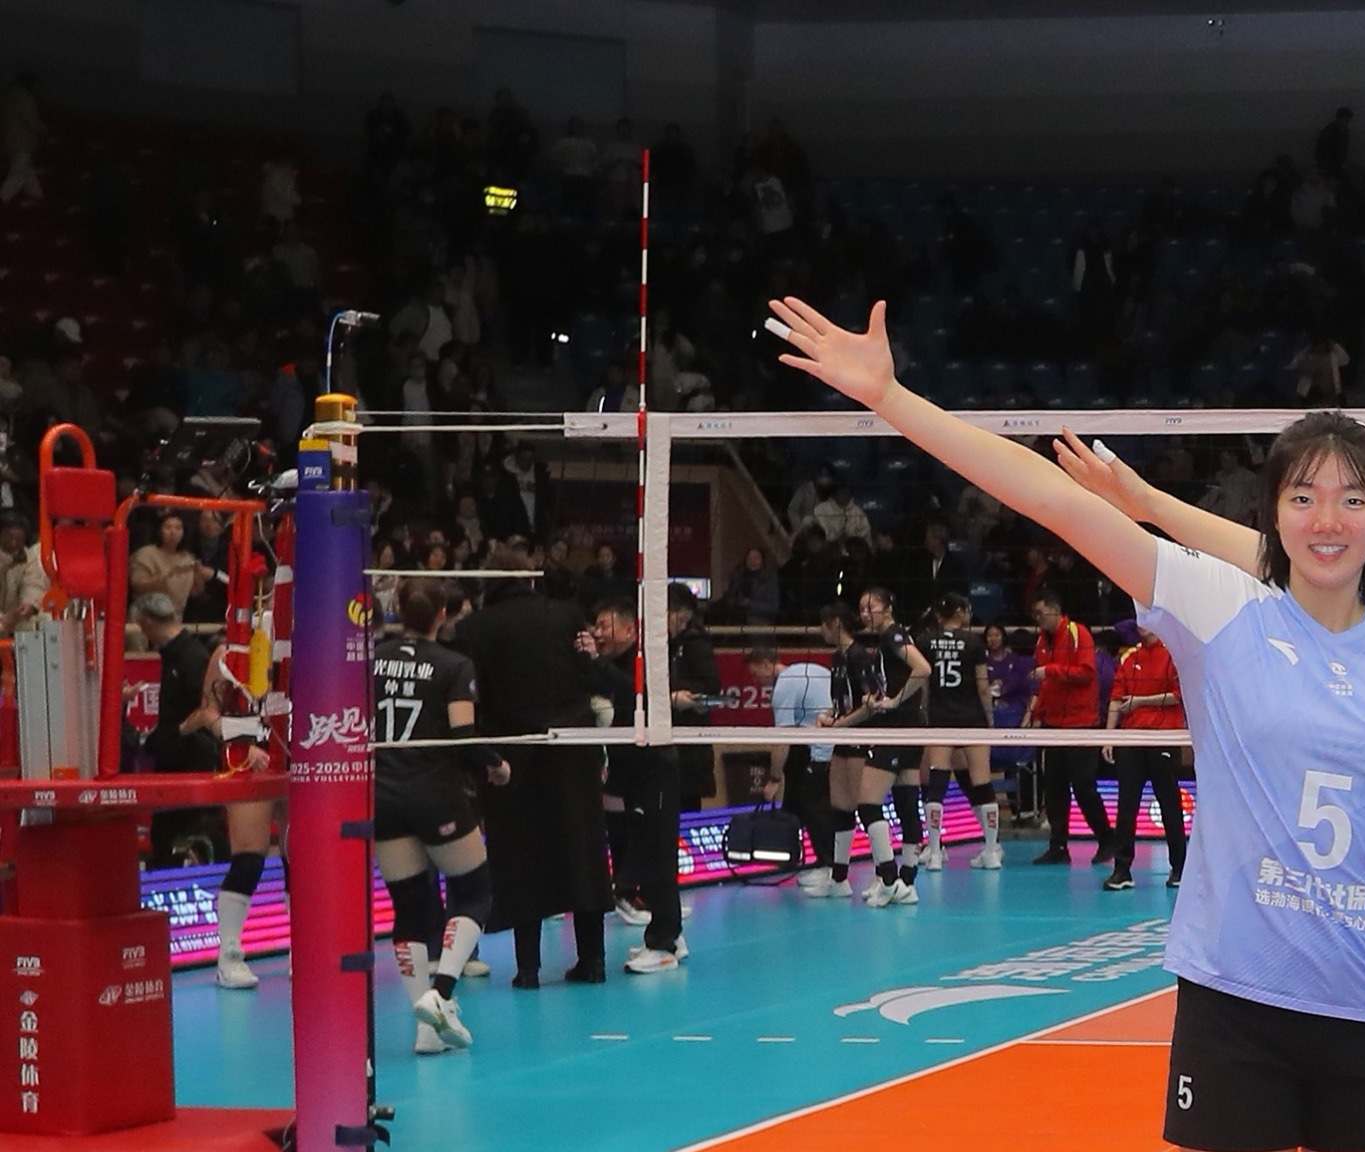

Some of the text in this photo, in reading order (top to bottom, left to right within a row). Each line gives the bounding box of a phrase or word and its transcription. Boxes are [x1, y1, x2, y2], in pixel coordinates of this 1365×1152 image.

[935, 661, 962, 688] 15
[718, 686, 773, 709] 025
[378, 698, 423, 743] 17
[1297, 769, 1353, 870] 5
[17, 957, 40, 968] FIVB
[1177, 1075, 1194, 1110] 5
